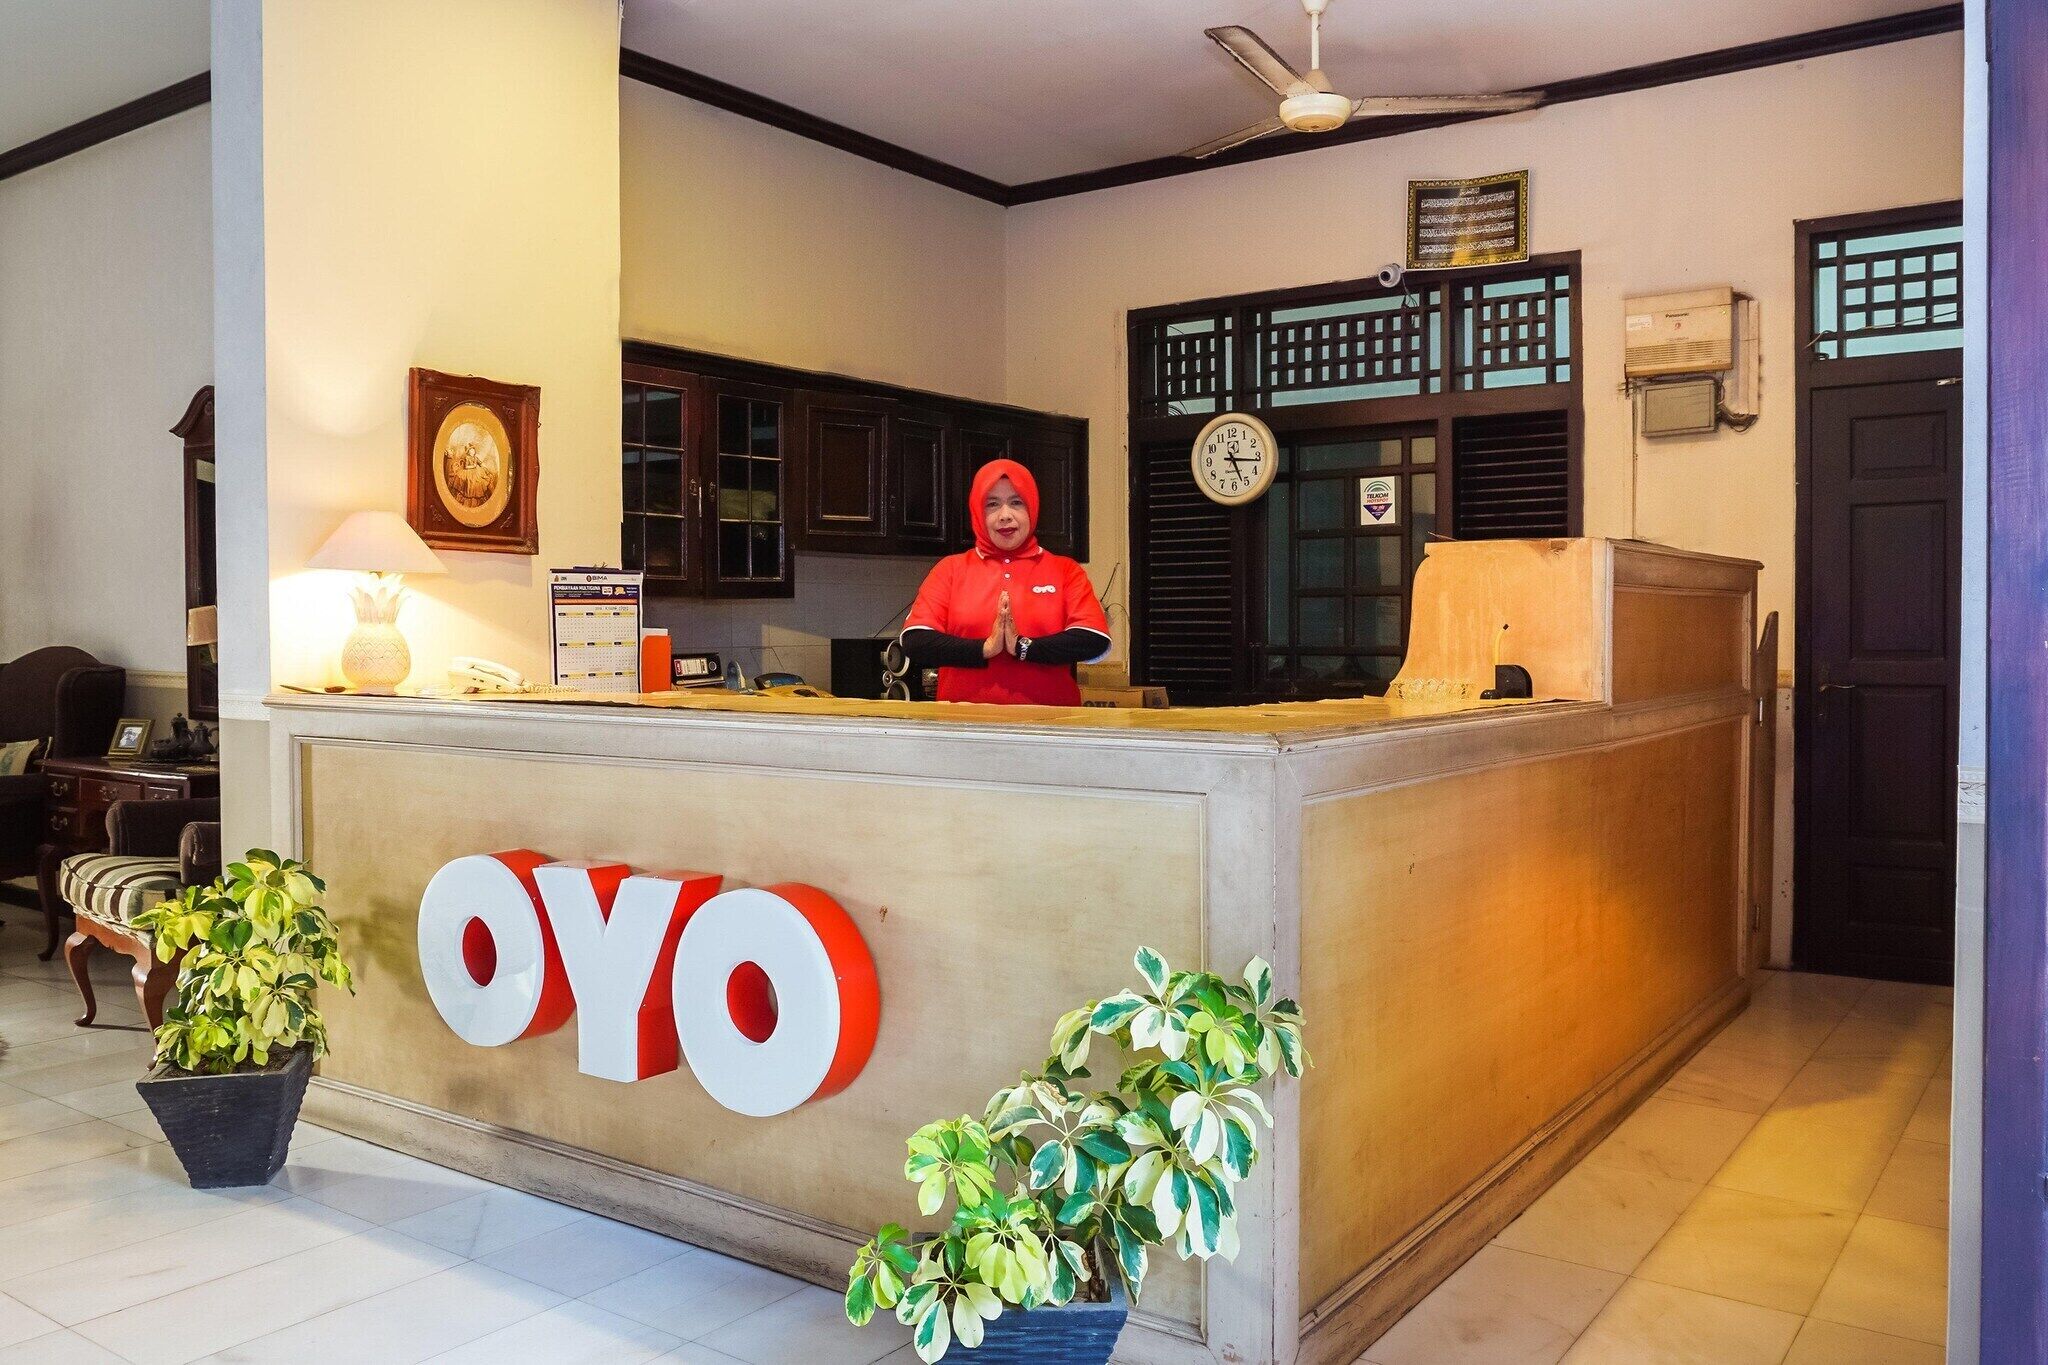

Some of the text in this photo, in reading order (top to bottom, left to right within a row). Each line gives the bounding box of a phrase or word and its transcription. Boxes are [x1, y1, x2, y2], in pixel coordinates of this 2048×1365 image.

[1227, 427, 1237, 438] 12
[1242, 430, 1247, 440] 1
[1217, 434, 1224, 443] 11
[1250, 438, 1257, 448] 2
[1208, 444, 1217, 454] 10
[1255, 451, 1261, 462] 3
[1206, 457, 1213, 467] 9
[1210, 470, 1216, 480] 8
[1252, 465, 1258, 475] 4
[1219, 479, 1226, 489] 7
[1231, 481, 1237, 491] 6
[1243, 476, 1250, 486] 5
[417, 849, 880, 1118] OYO
